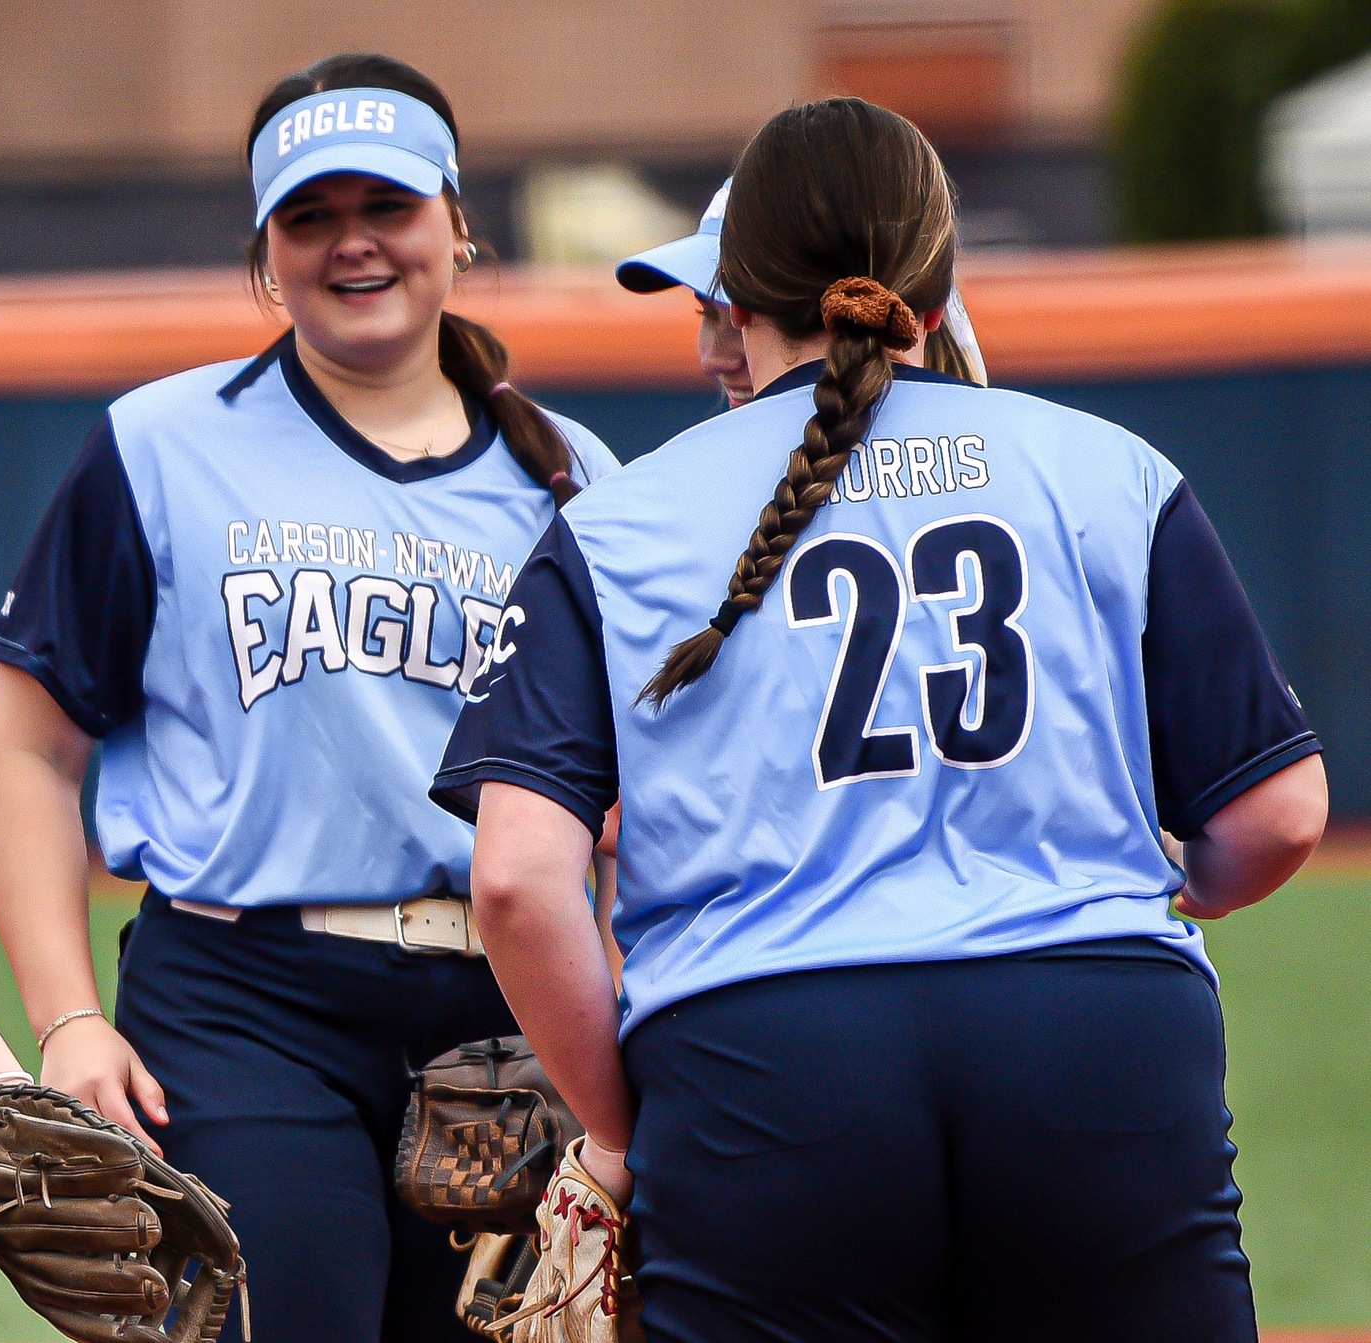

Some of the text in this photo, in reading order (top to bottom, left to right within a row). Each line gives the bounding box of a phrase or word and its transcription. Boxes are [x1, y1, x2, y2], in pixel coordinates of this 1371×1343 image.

[276, 99, 397, 158] EAGLES
[822, 433, 991, 507] ORRIS
[782, 512, 1036, 792] 23
